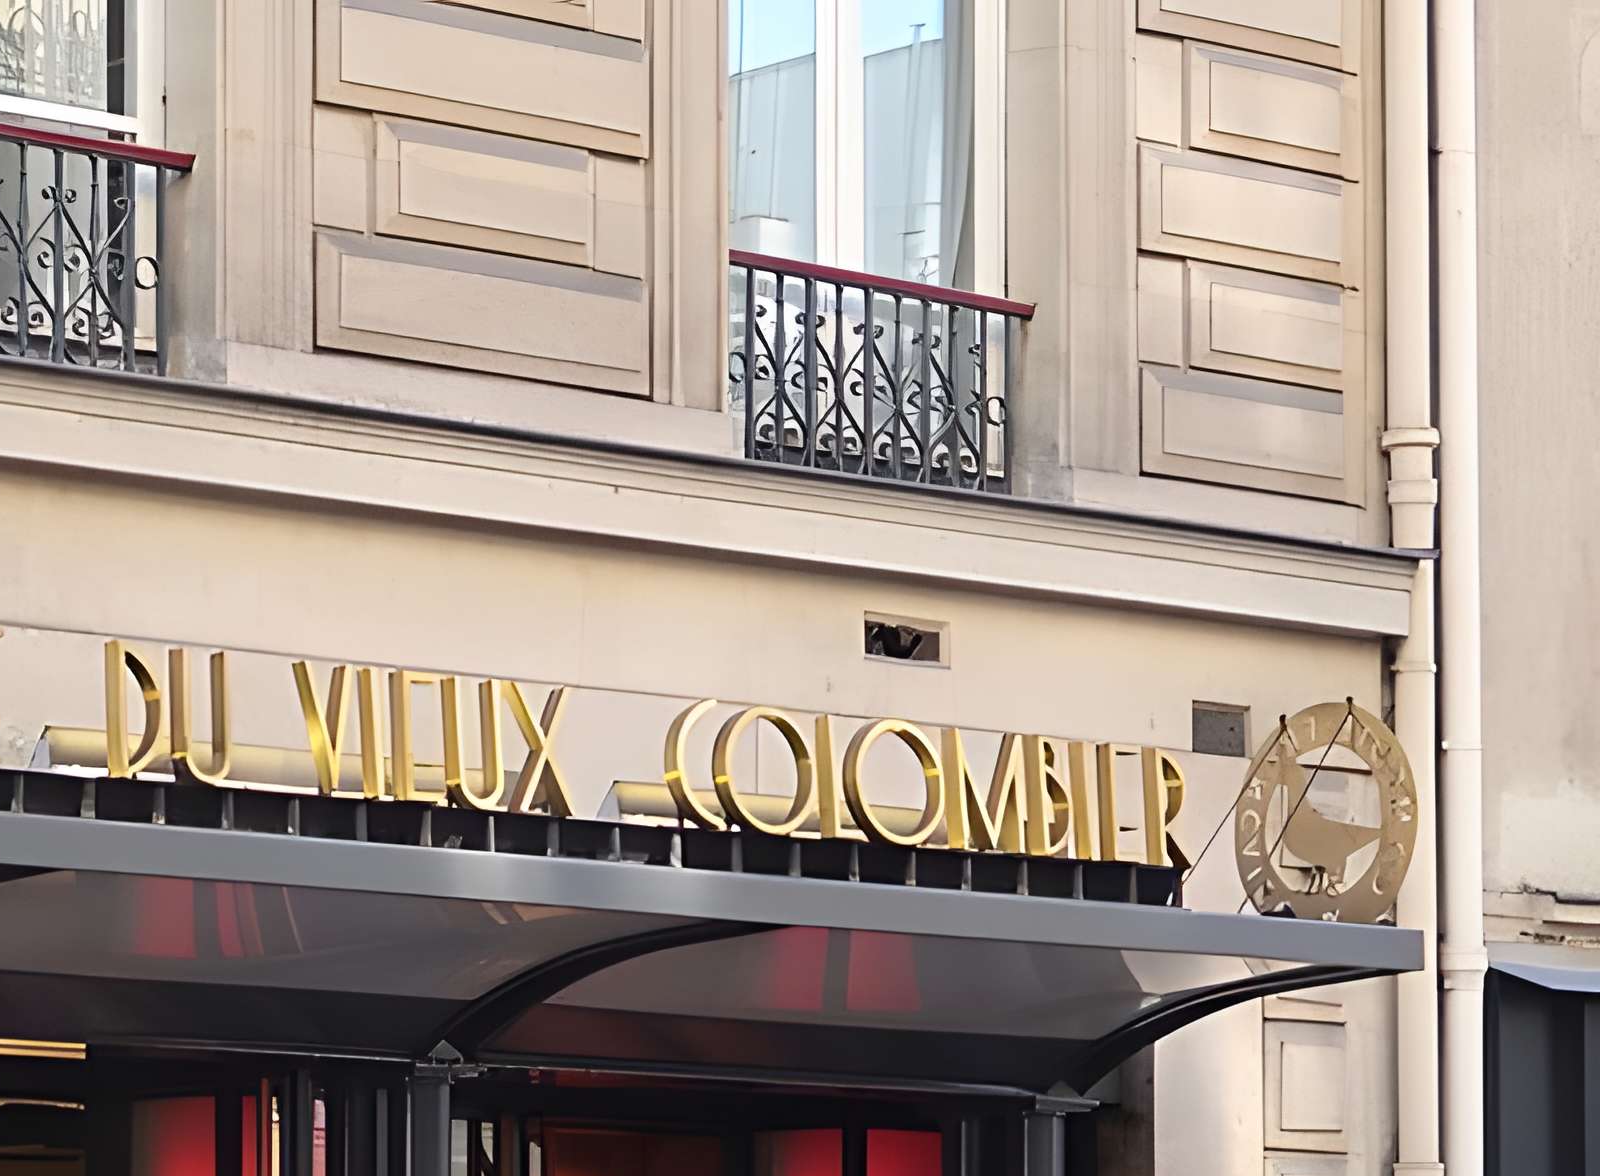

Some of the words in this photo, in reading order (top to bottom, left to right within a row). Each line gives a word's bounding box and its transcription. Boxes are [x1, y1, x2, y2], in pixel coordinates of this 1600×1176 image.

[104, 640, 231, 780] DU
[292, 660, 574, 817] VIEUX
[663, 699, 1192, 869] COLOMBIER
